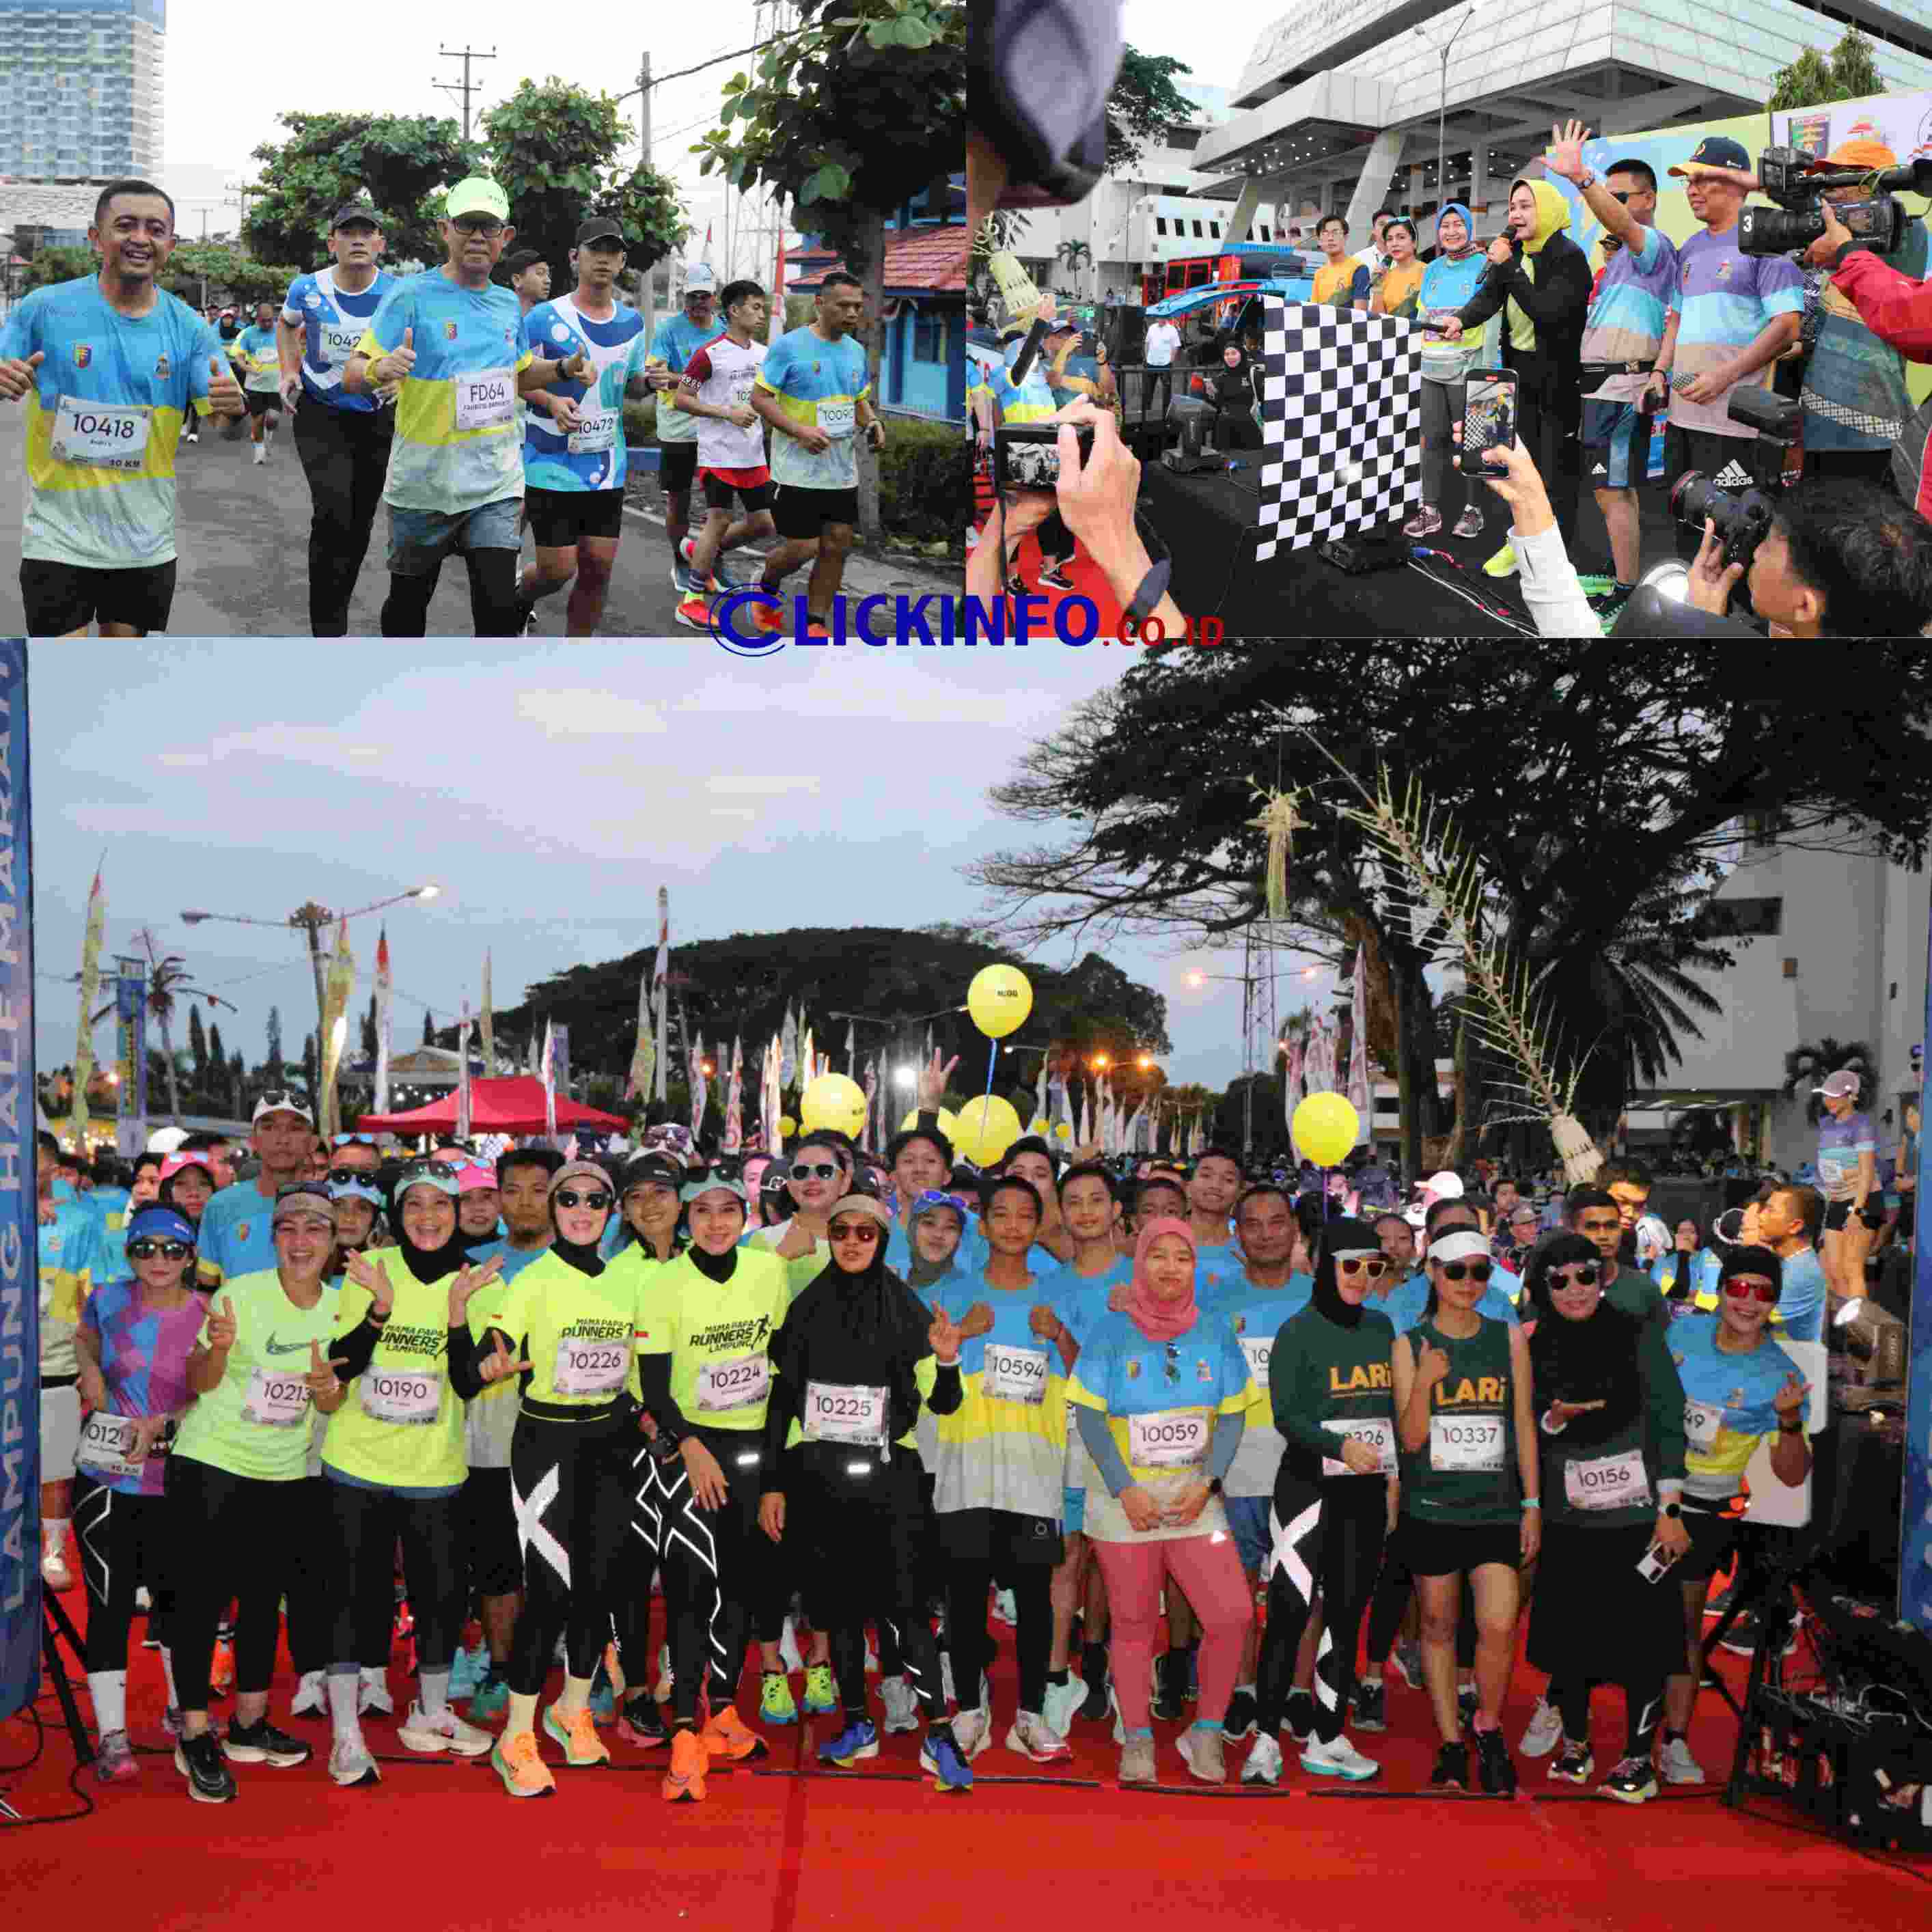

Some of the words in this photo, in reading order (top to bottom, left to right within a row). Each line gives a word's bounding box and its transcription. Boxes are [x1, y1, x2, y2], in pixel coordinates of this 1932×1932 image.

[1743, 215, 1753, 233] 3
[470, 383, 504, 403] FD64
[73, 412, 135, 439] 10418
[579, 417, 613, 434] 10472
[1713, 475, 1756, 487] adidas
[0, 991, 20, 1191] HALF
[376, 1331, 439, 1349] UNNERS
[561, 1325, 624, 1340] RUNNERS
[689, 1327, 754, 1347] RUNNERS
[569, 1351, 621, 1370] 10226
[993, 1355, 1044, 1378] 10594
[710, 1363, 760, 1389] 10224
[373, 1377, 427, 1399] 10190
[816, 1395, 871, 1417] 10225
[1, 1222, 25, 1613] LAMPUNG
[1141, 1423, 1199, 1442] 10059
[1443, 1426, 1498, 1444] 10337
[1577, 1465, 1630, 1487] 10156
